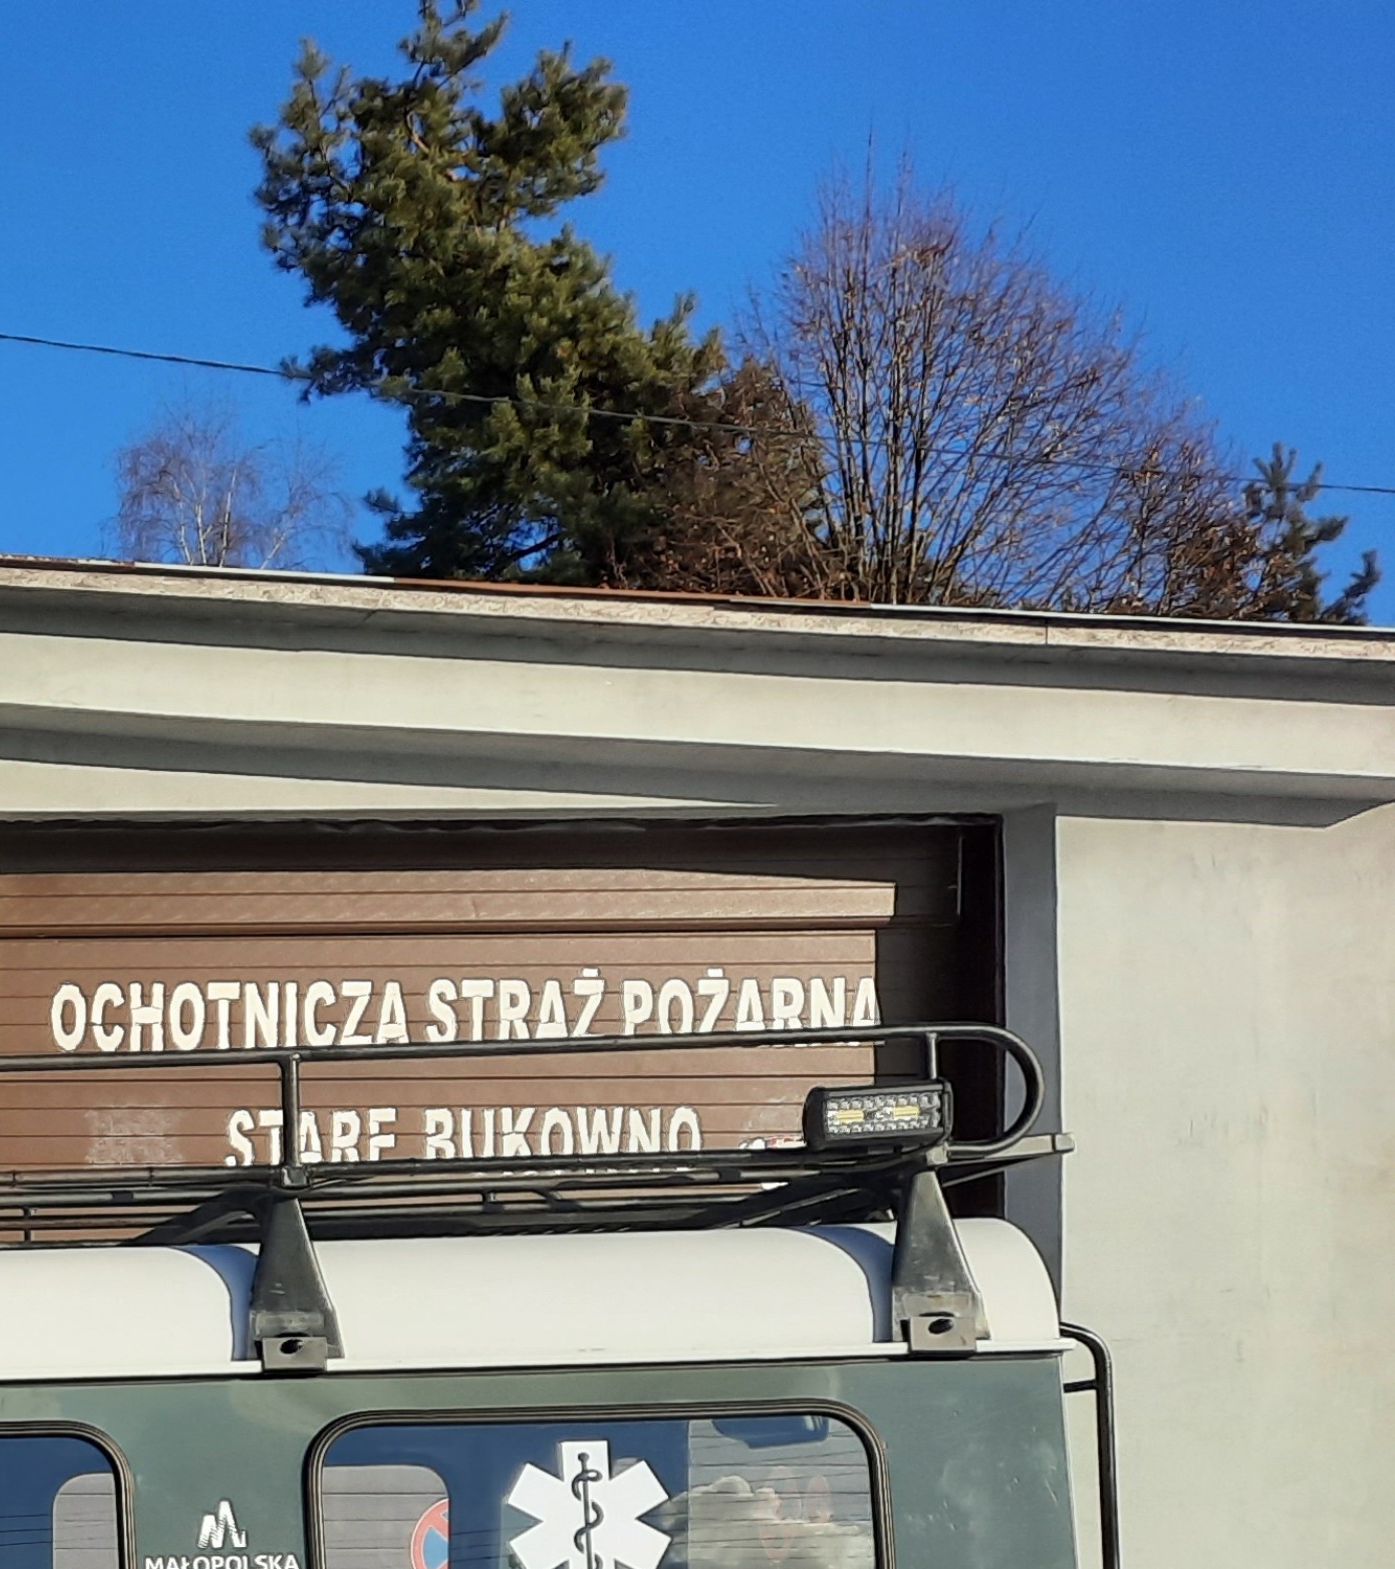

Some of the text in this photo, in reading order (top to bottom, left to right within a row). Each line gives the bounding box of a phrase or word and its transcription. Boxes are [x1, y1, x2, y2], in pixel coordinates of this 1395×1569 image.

[51, 967, 879, 1052] OCHOTNICZA STRAŻ POŻARNA
[424, 1105, 701, 1172] BUKOWNO
